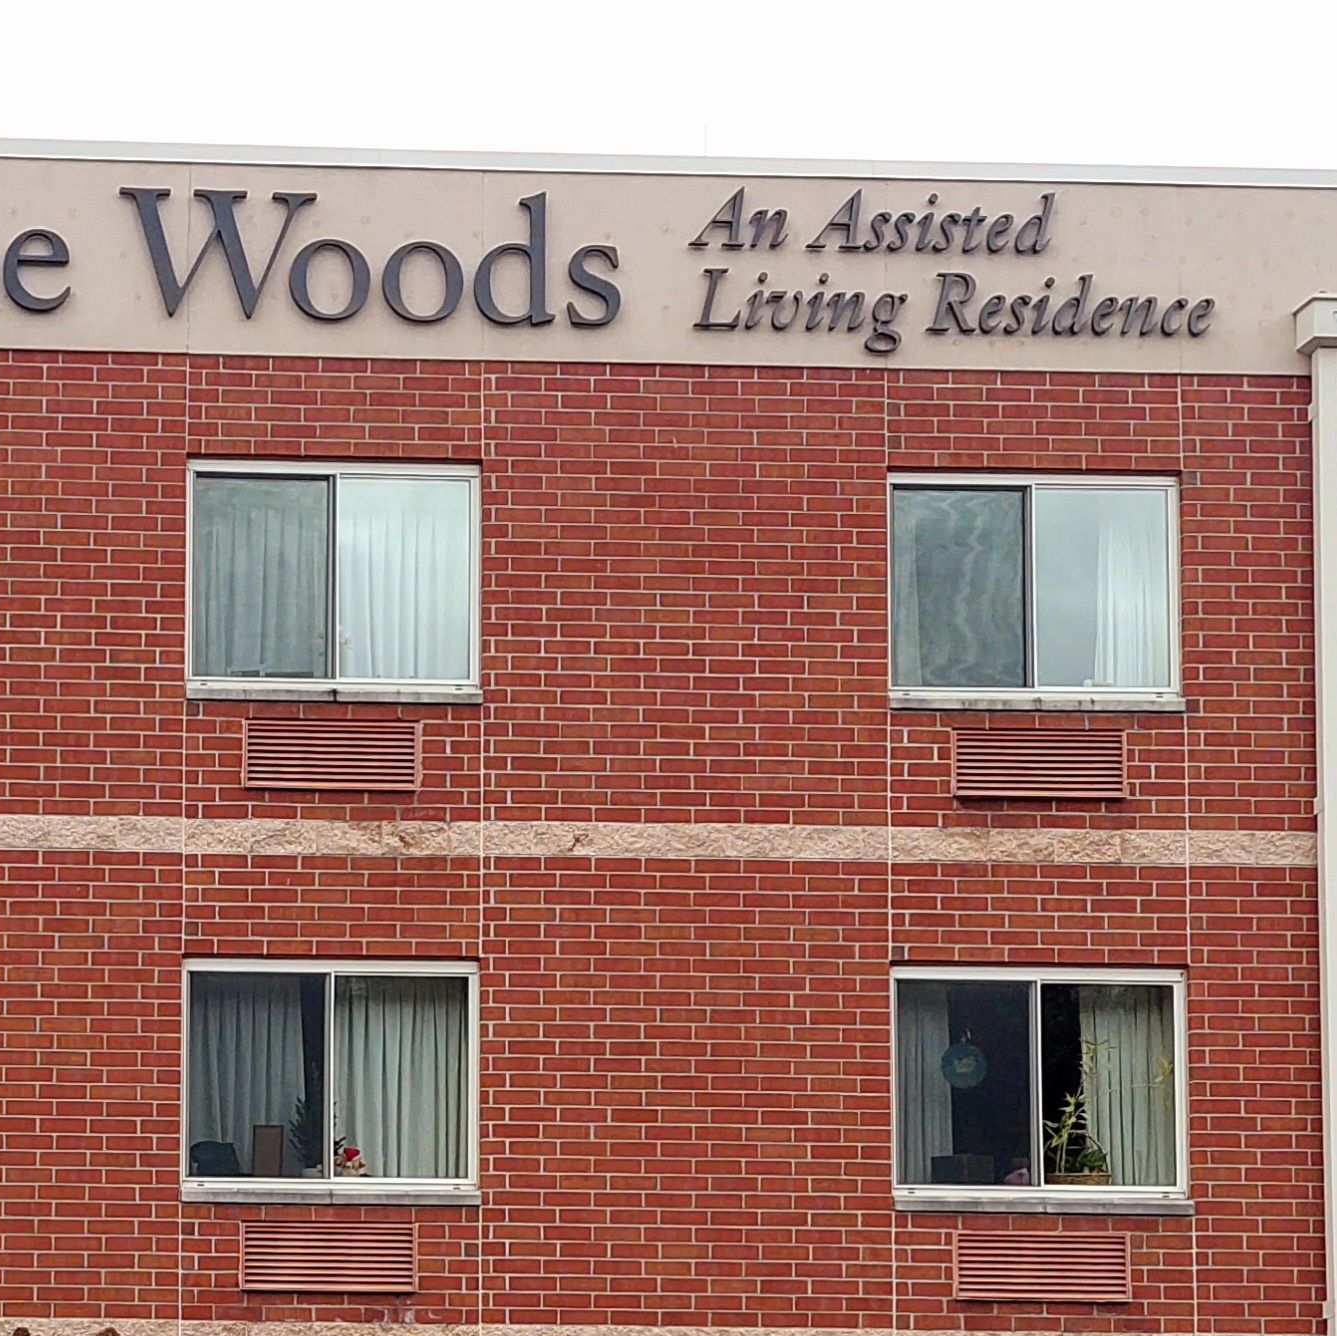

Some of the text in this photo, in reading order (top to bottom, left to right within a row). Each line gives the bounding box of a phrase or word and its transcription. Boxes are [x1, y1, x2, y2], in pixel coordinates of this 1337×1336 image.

[119, 186, 622, 328] Woods
[688, 185, 1056, 256] An Assisted
[693, 267, 1216, 354] Living Residence
